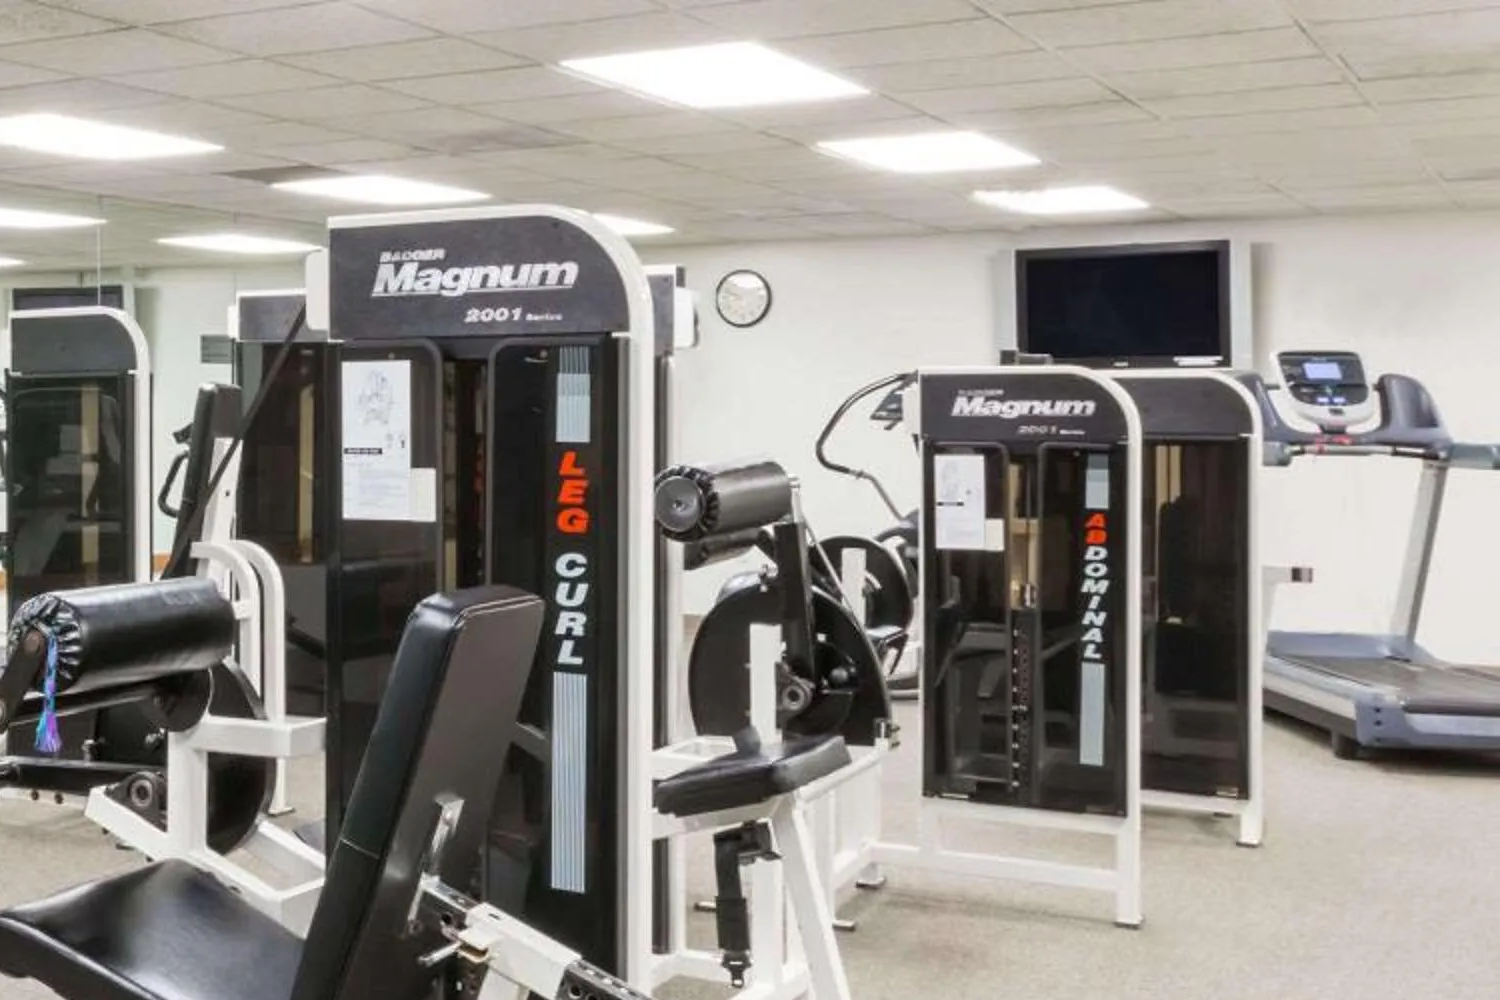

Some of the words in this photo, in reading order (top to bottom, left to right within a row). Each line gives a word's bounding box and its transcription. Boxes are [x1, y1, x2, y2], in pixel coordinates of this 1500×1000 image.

[371, 261, 580, 298] Magnum
[464, 306, 523, 324] 2001
[950, 395, 1097, 419] Magnum
[555, 451, 590, 533] LEG
[554, 552, 589, 666] CURL
[1081, 512, 1108, 659] ABDOMINAL
